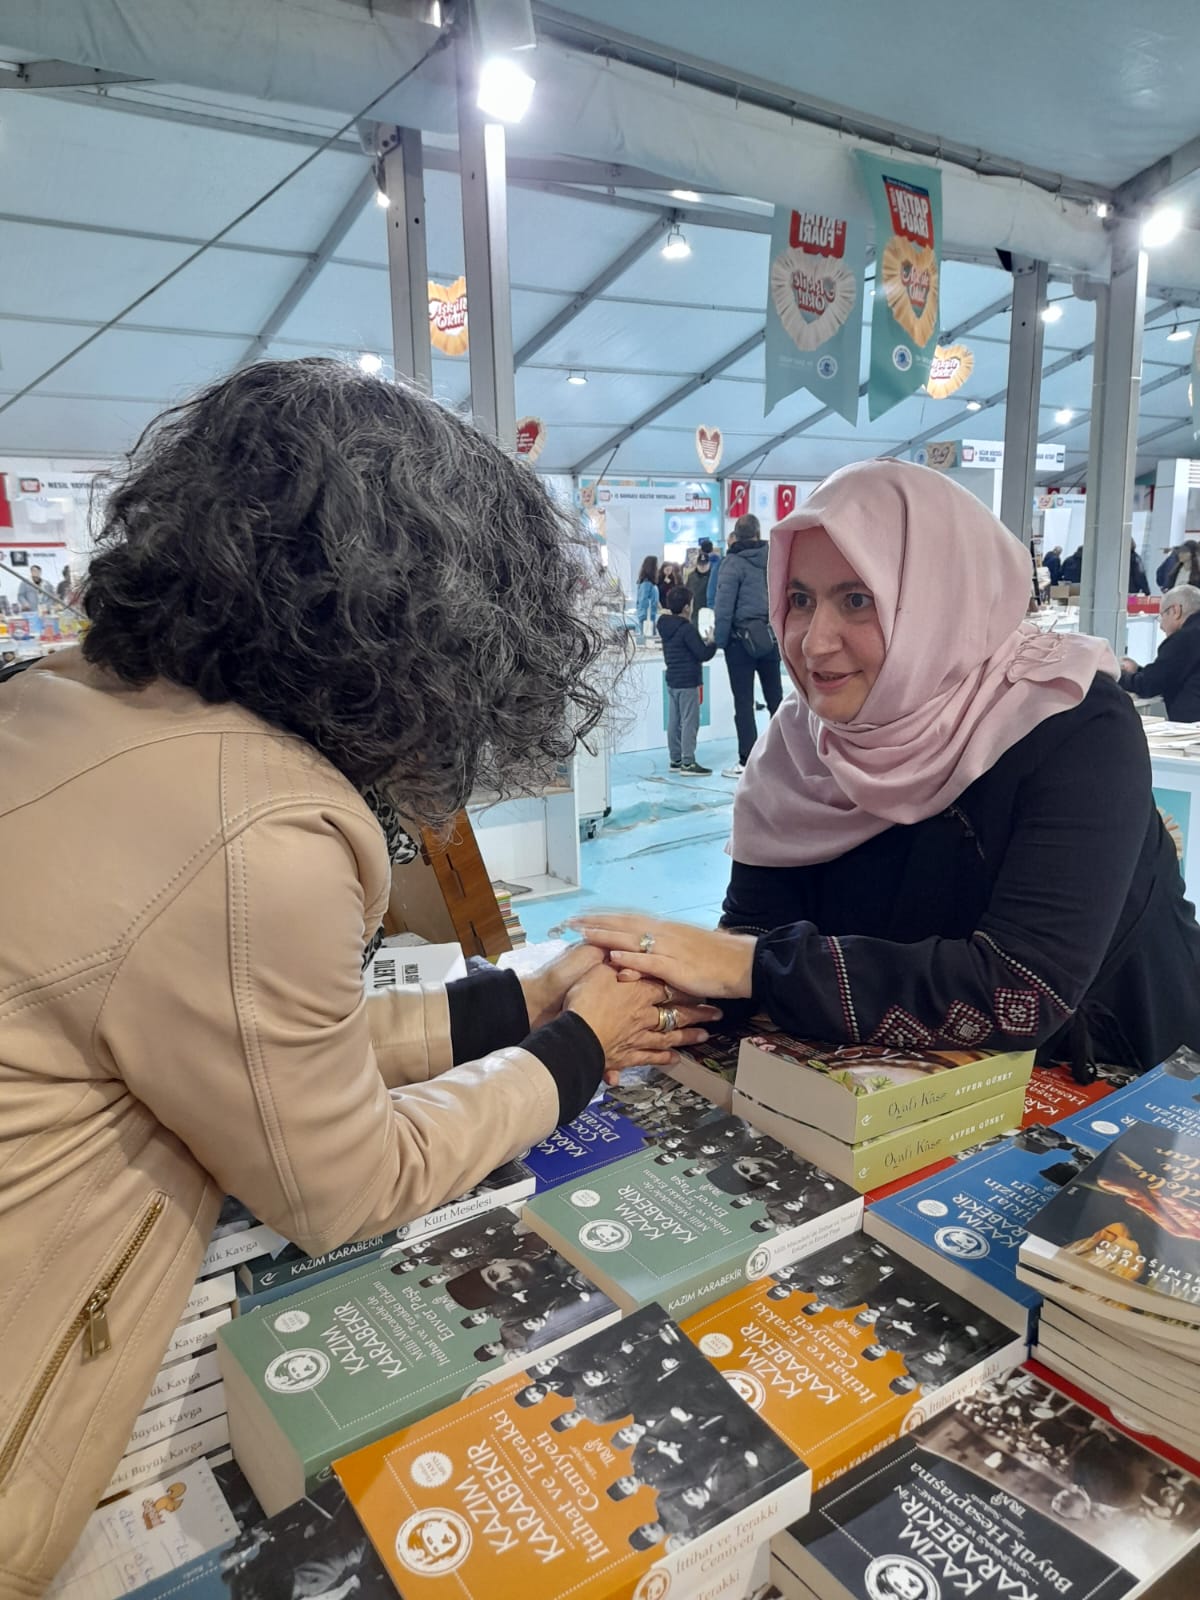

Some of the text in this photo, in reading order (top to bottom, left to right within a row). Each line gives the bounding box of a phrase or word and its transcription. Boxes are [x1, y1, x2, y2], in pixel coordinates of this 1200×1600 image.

[373, 959, 396, 978] DİLEK
[580, 1110, 621, 1143] Davam
[450, 1197, 492, 1219] Meselesi
[617, 1184, 698, 1244] KARABEKİR
[670, 1174, 729, 1218] Enver Paşa
[952, 1192, 1031, 1238] RABEKİR
[614, 1202, 665, 1241] KAZIM
[957, 1210, 1021, 1249] KAZIM
[201, 1240, 259, 1267] yük Kavga
[290, 1234, 384, 1276] KAZIM KARABEKİR
[1095, 1246, 1140, 1273] TUNA
[185, 1295, 210, 1309] avga
[668, 1267, 743, 1312] KAZIM KARABEKİR
[392, 1305, 420, 1332] Terakki
[401, 1286, 456, 1343] Enver Paşa
[417, 1329, 430, 1341] ve
[750, 1301, 806, 1348] Terakki
[174, 1332, 209, 1350] Kavga
[319, 1324, 370, 1376] KAZIM
[333, 1301, 408, 1380] KARABEKİR
[404, 1342, 427, 1362] Milli
[790, 1314, 859, 1369] Cemiyeti
[807, 1345, 826, 1362] ve
[167, 1372, 201, 1390] Kavga
[739, 1346, 803, 1400] KAZIM
[740, 1321, 842, 1406] KARABEKİR
[824, 1360, 877, 1404] İttihat
[130, 1406, 202, 1441] Büyük Kavga
[131, 1456, 167, 1475] Büyük
[169, 1441, 203, 1459] Kavga
[531, 1430, 599, 1512] Cemiyeti
[467, 1438, 565, 1564] KARABEKİR
[489, 1408, 610, 1564] İttihat ve Terakki
[454, 1474, 519, 1555] KAZIM
[717, 1533, 732, 1547] ve
[735, 1502, 780, 1538] Terakki
[910, 1462, 1074, 1595] Büyük Hesaplaşma
[700, 1532, 755, 1574] Cemiyeti
[898, 1523, 983, 1596] KAZIM
